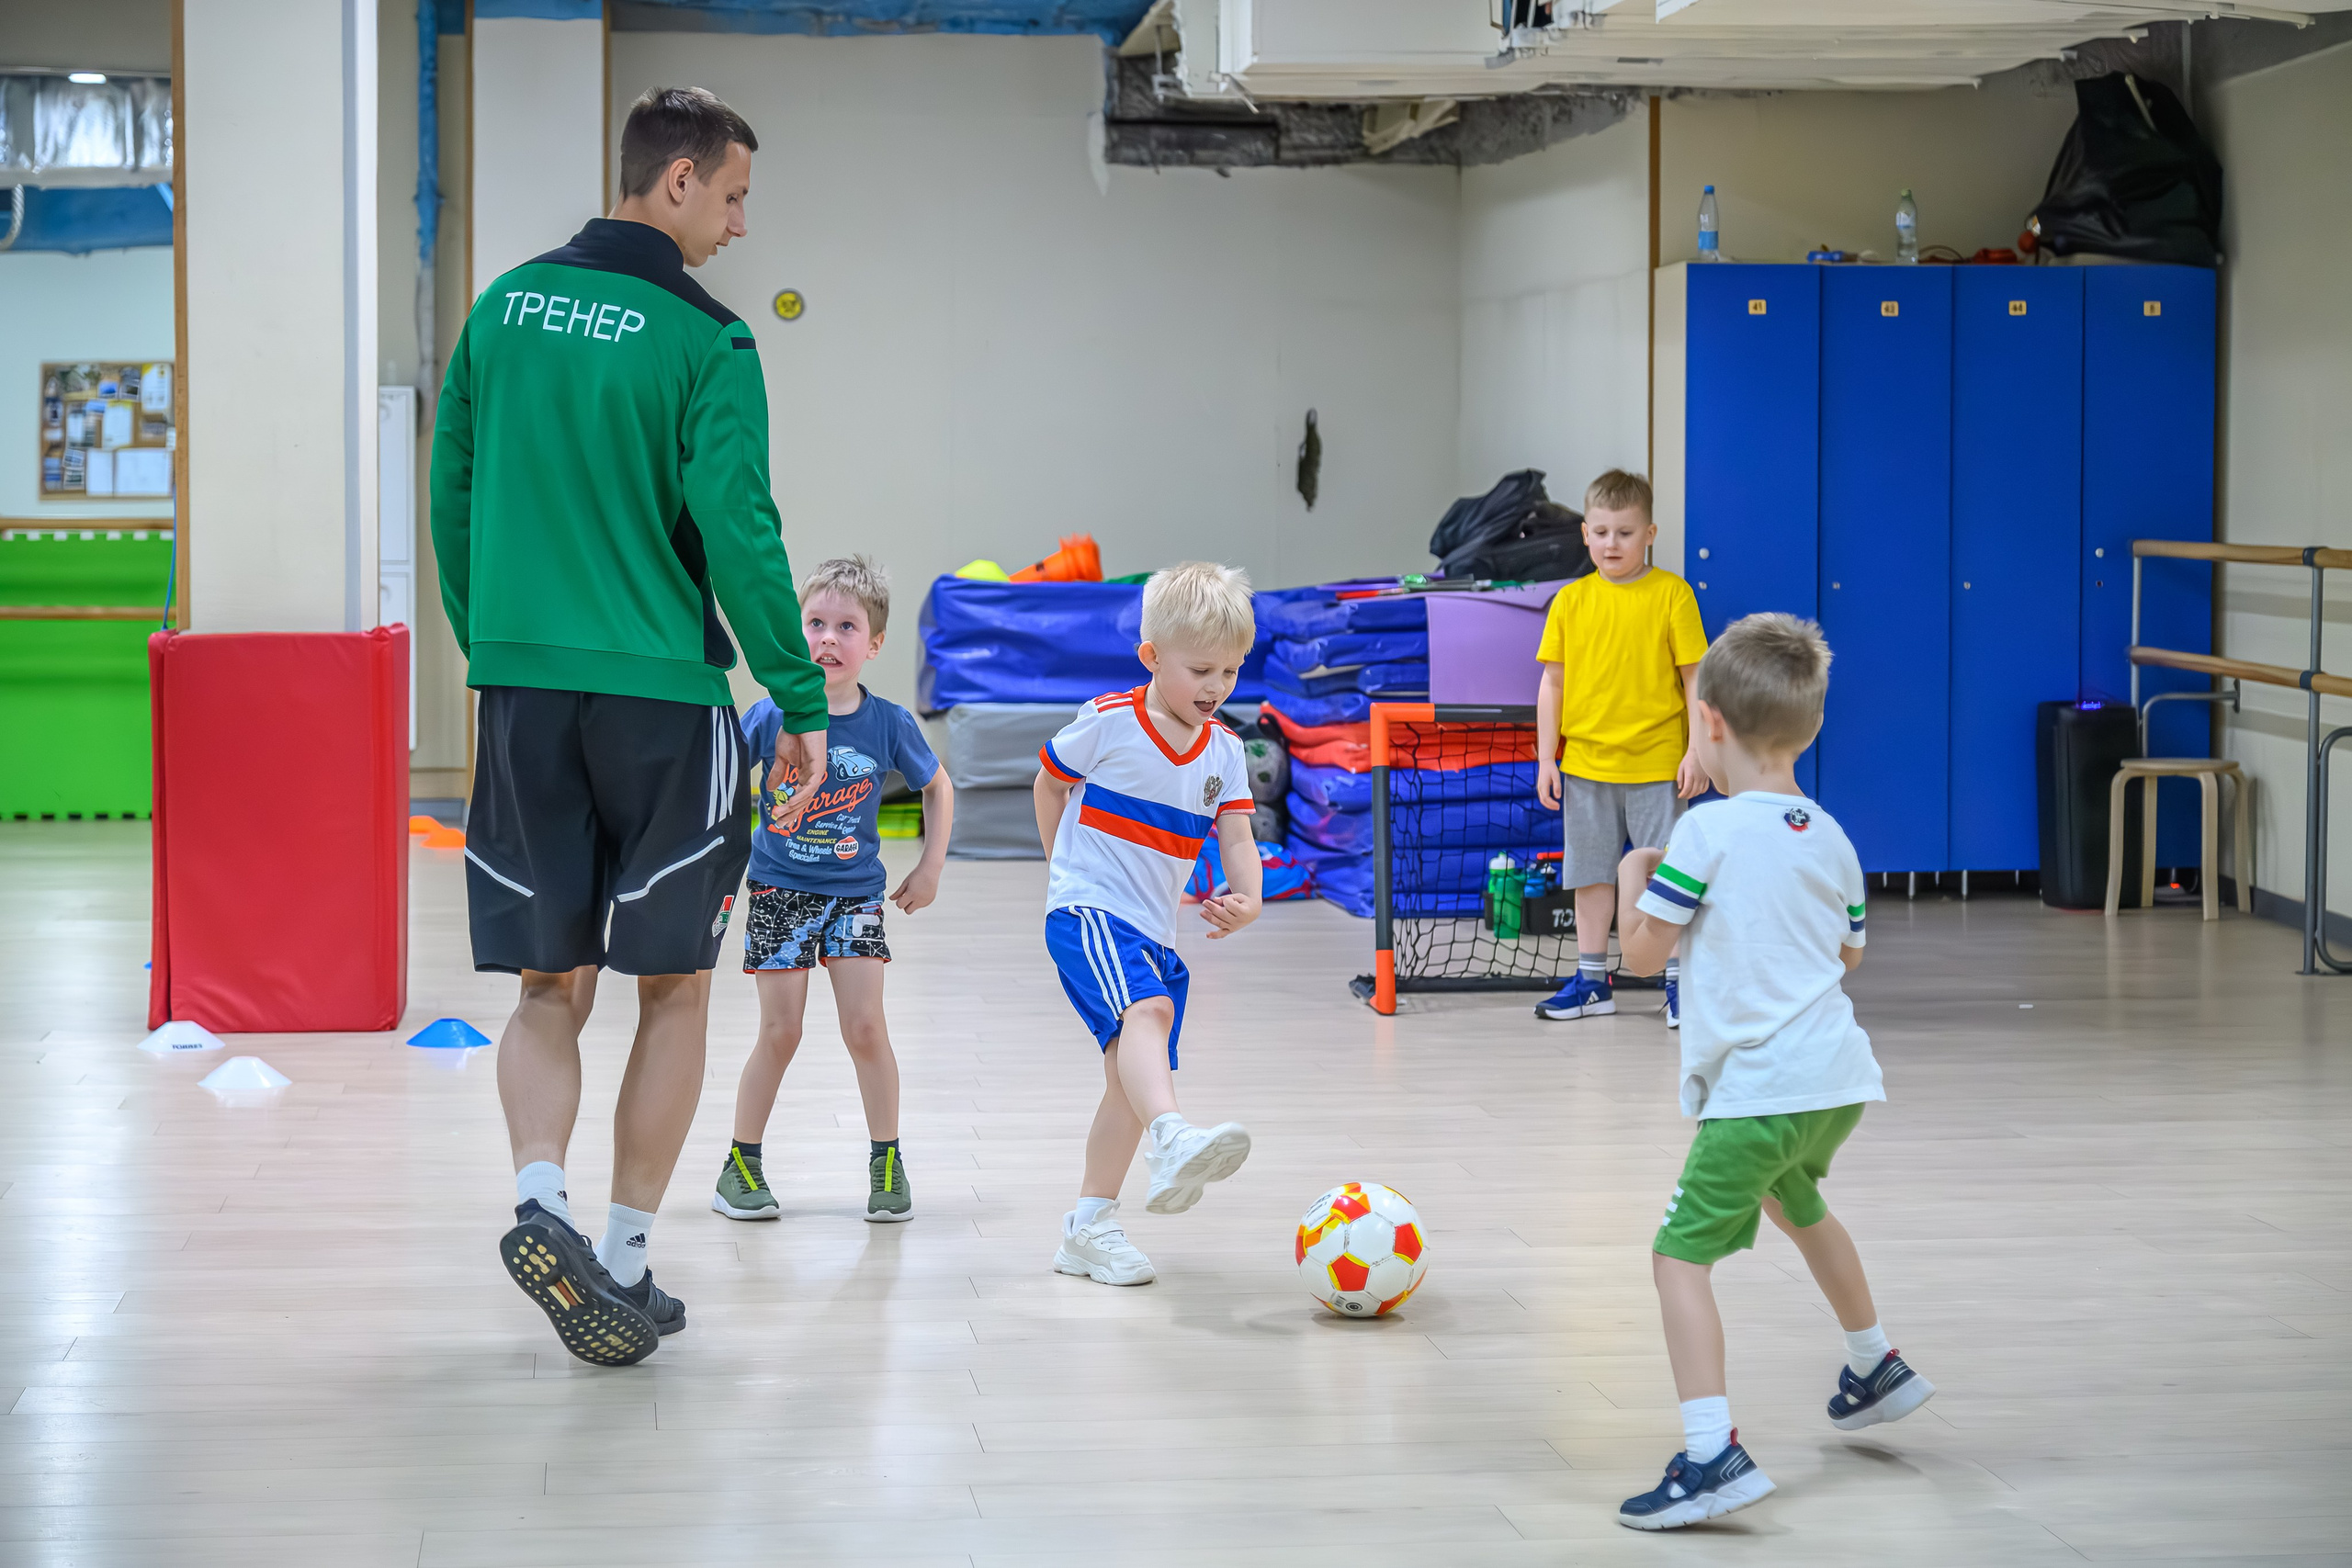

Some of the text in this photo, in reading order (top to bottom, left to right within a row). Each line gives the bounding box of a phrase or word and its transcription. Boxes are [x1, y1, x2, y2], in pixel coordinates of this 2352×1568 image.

[503, 291, 646, 343] ТРЕНЕР
[797, 835, 837, 844] MAINTENANCE
[801, 844, 808, 852] &
[808, 844, 832, 855] Wheels
[835, 842, 858, 852] GARAGE
